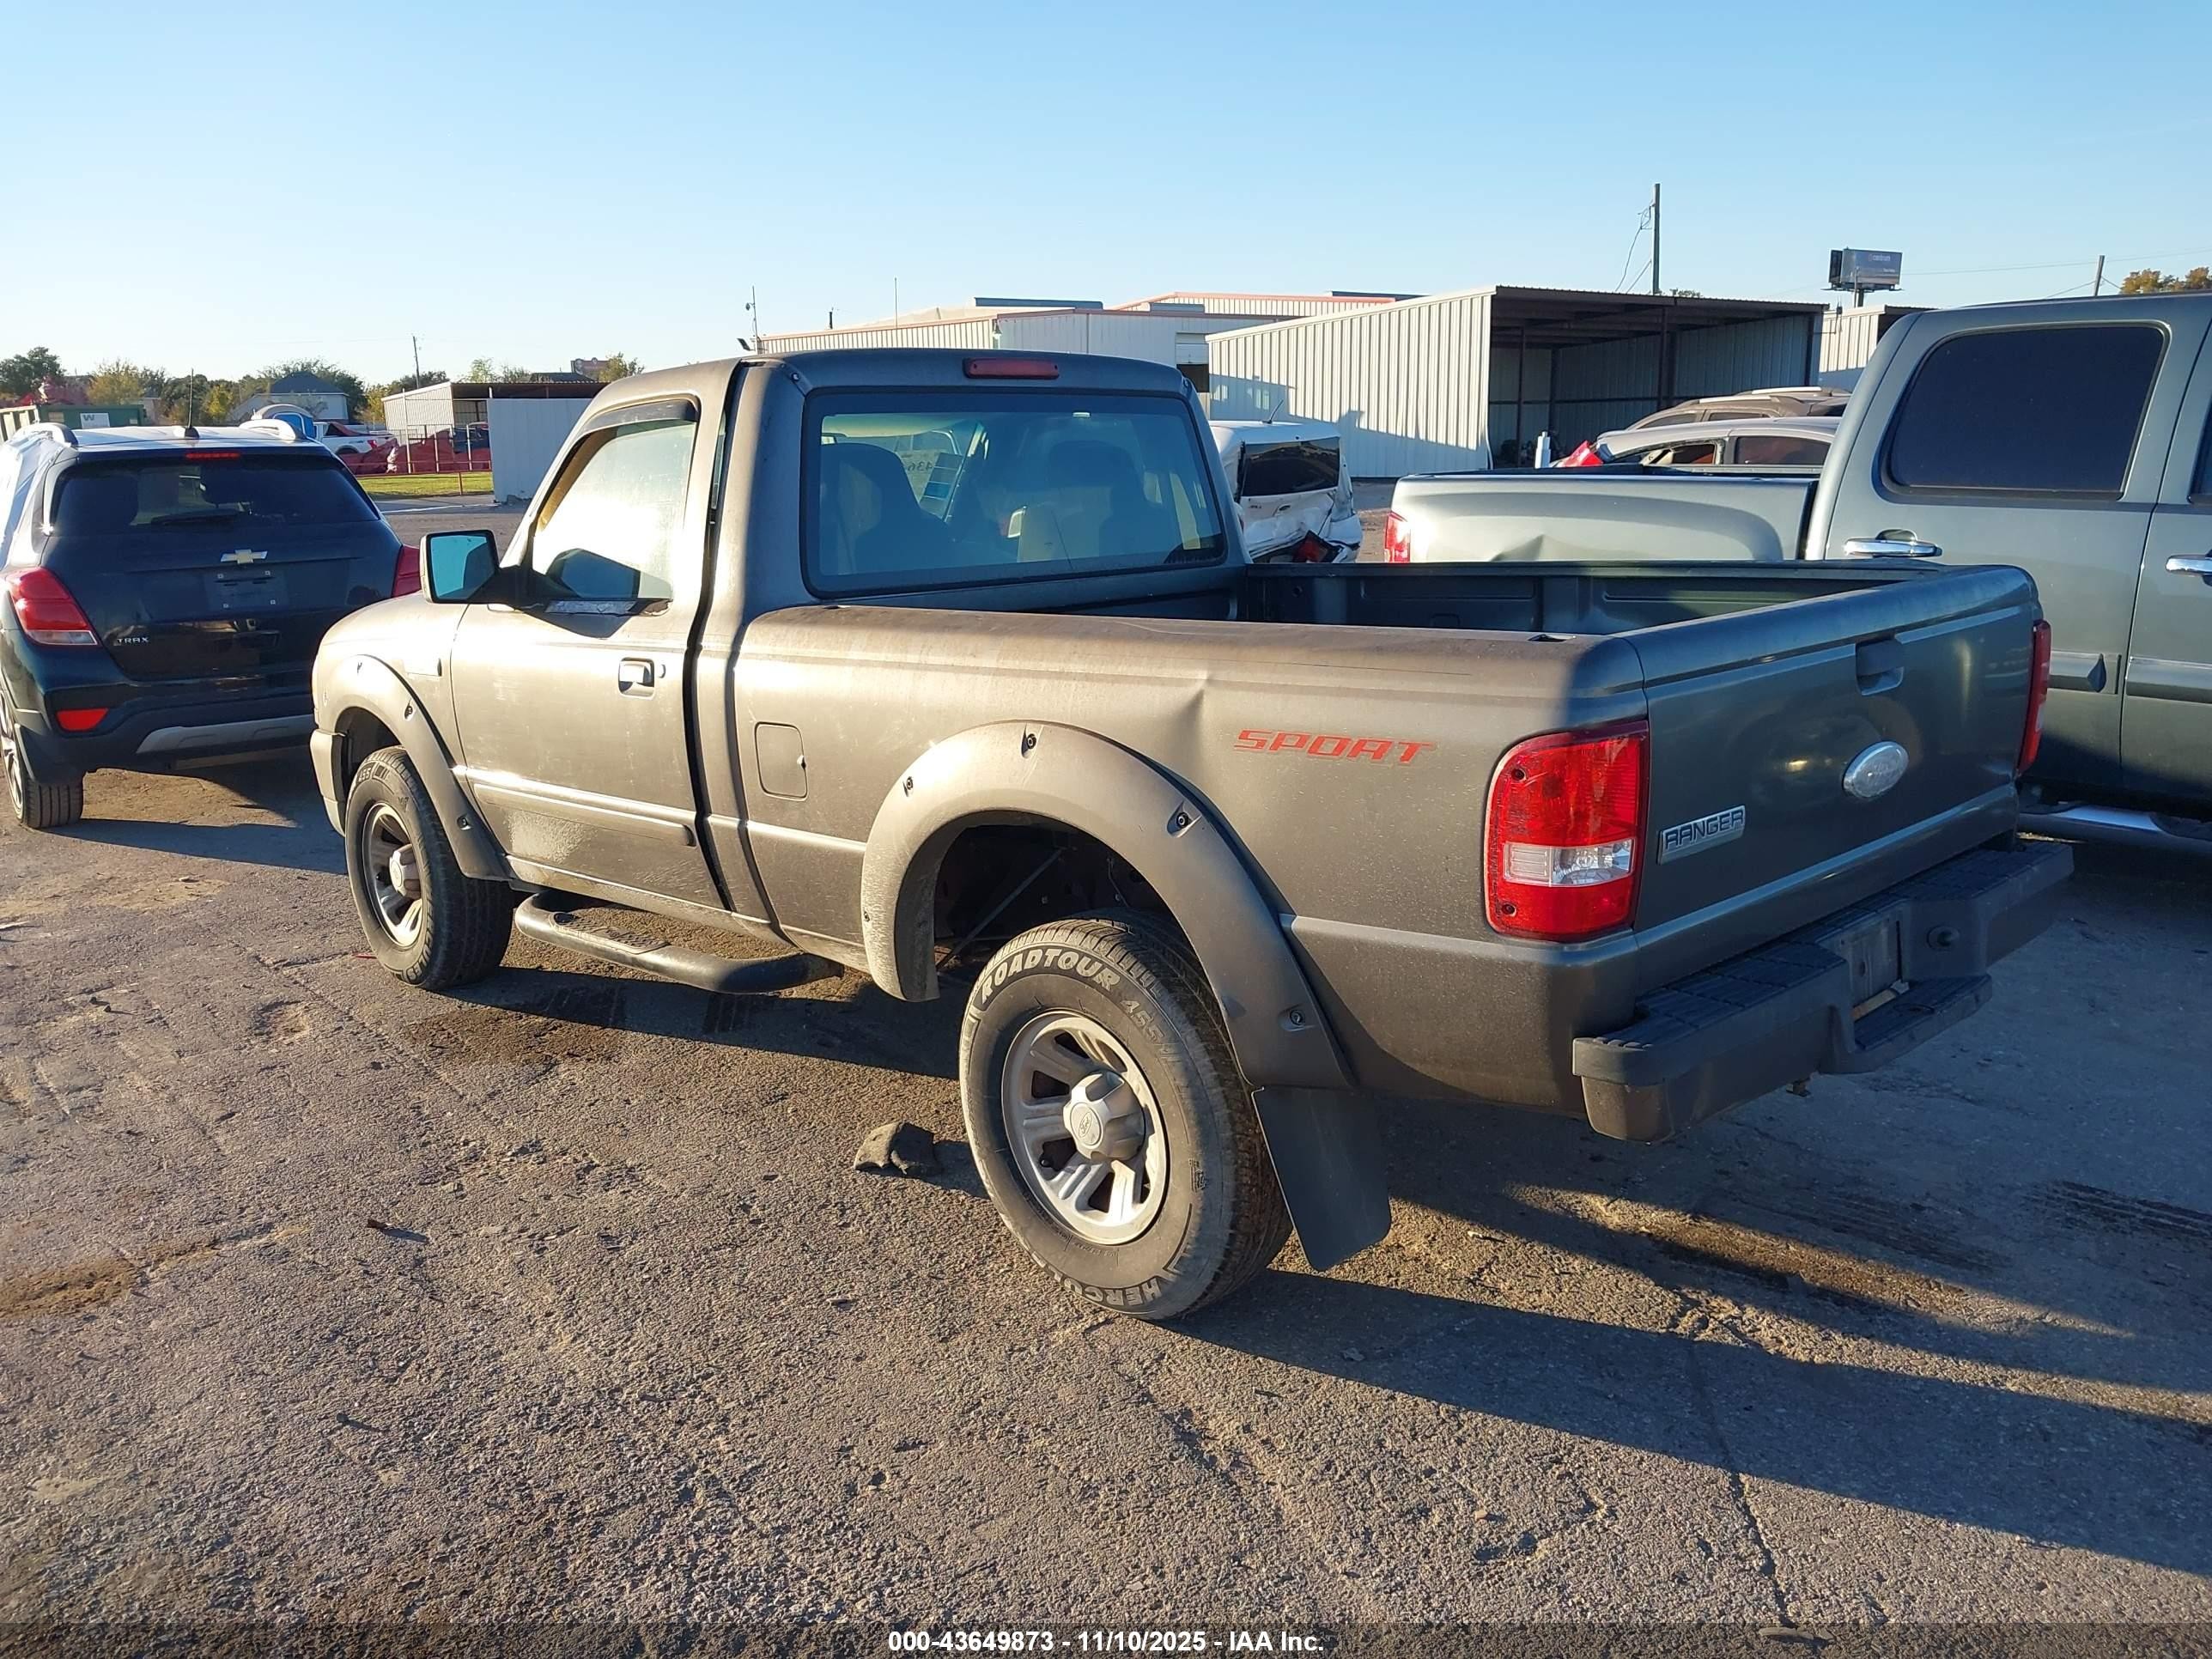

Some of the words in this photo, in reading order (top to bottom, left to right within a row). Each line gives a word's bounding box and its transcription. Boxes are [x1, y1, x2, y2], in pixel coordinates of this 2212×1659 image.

[1234, 729, 1437, 765] SPORT
[1664, 810, 1744, 850] RANGER
[981, 947, 1122, 1006] ROADTOUR
